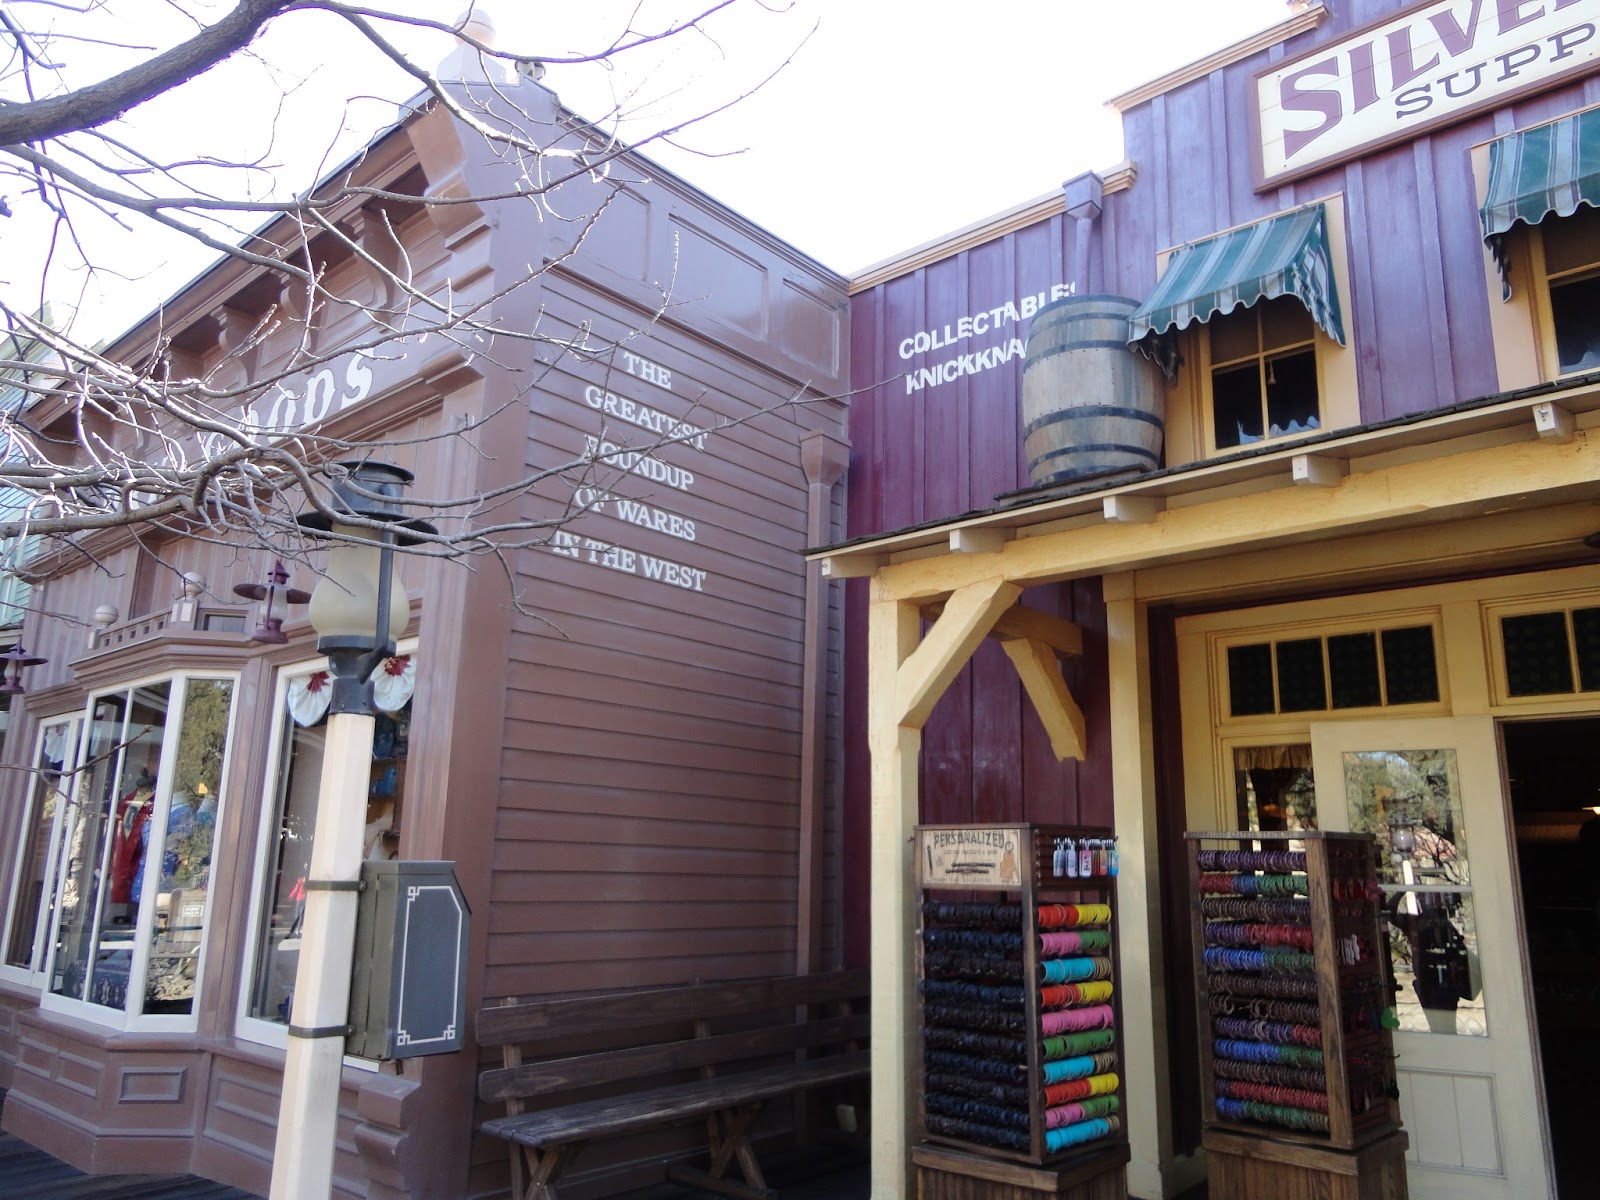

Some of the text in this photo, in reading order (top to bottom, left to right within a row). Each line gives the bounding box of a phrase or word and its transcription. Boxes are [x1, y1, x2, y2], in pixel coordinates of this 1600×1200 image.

[1280, 0, 1581, 160] SILVE
[1395, 22, 1596, 120] SUPP
[899, 282, 1076, 360] COLLECTABLE
[624, 352, 672, 390] THE
[906, 338, 1028, 396] KNICKKNA
[585, 385, 708, 450] GREATEST
[584, 434, 695, 491] ROUNDUP
[575, 487, 696, 542] OF WARES
[553, 529, 707, 591] IN THE WEST
[933, 829, 1005, 849] PERSONALIZED
